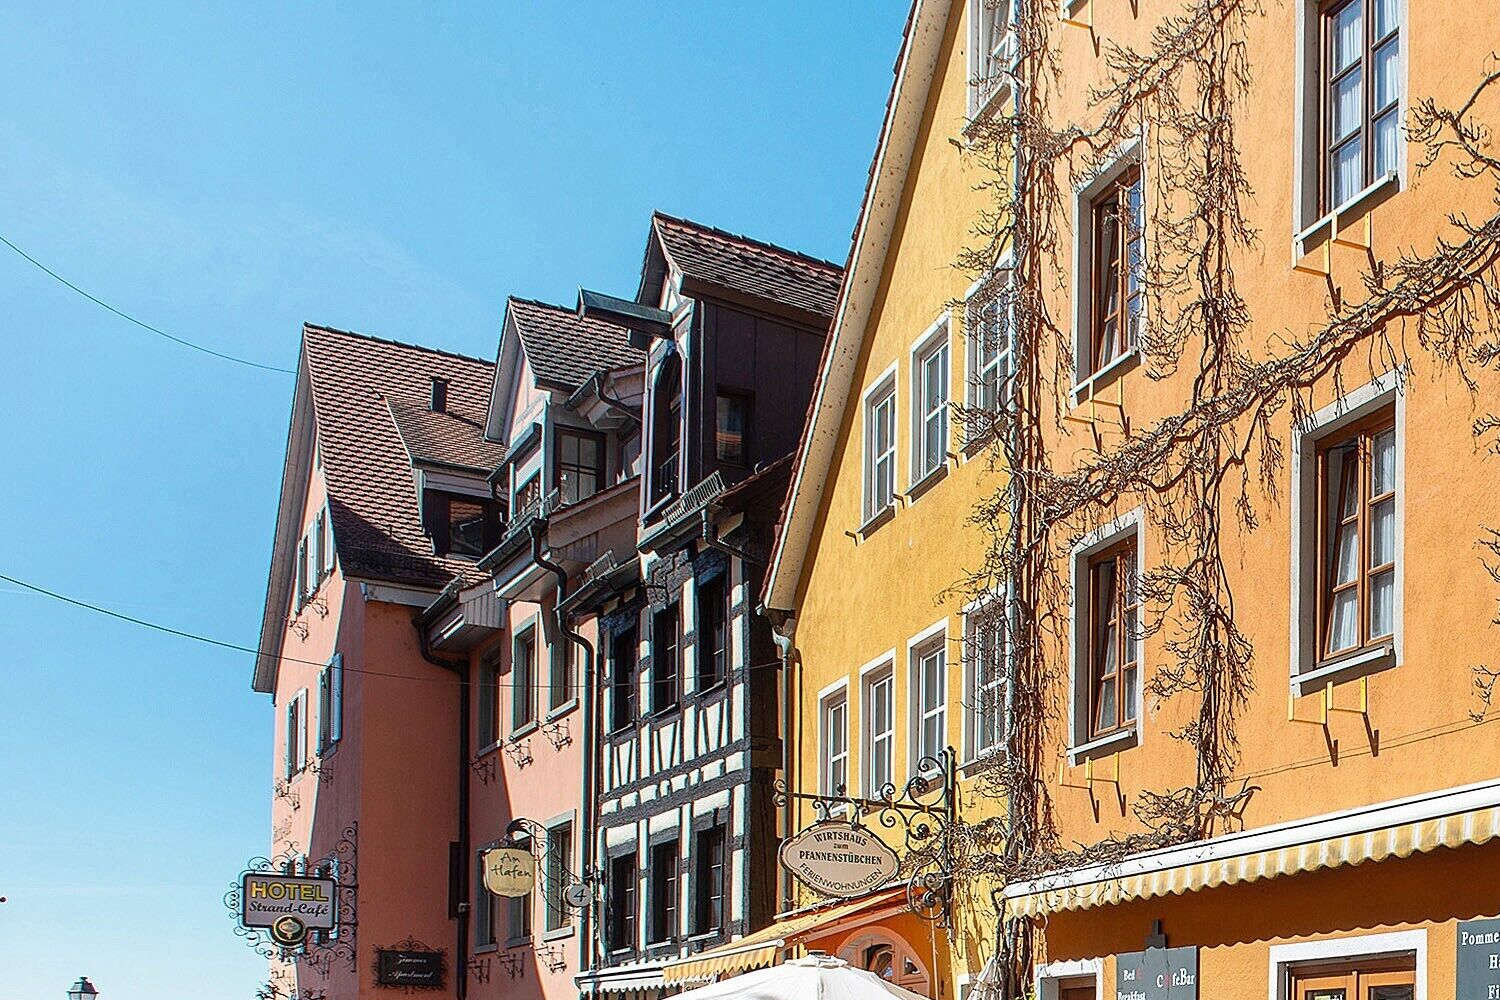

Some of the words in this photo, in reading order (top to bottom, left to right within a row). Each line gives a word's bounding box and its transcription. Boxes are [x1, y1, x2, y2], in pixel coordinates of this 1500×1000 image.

[814, 831, 868, 846] WIRTSHAUS
[500, 852, 520, 863] Am
[799, 850, 882, 865] PFANNENSTÜBCHEN
[490, 864, 532, 879] Hafen
[800, 862, 883, 891] FERIENWOHNUNGEN
[251, 882, 329, 902] HOTEL
[573, 888, 587, 902] 4
[249, 901, 329, 917] Strand-Café
